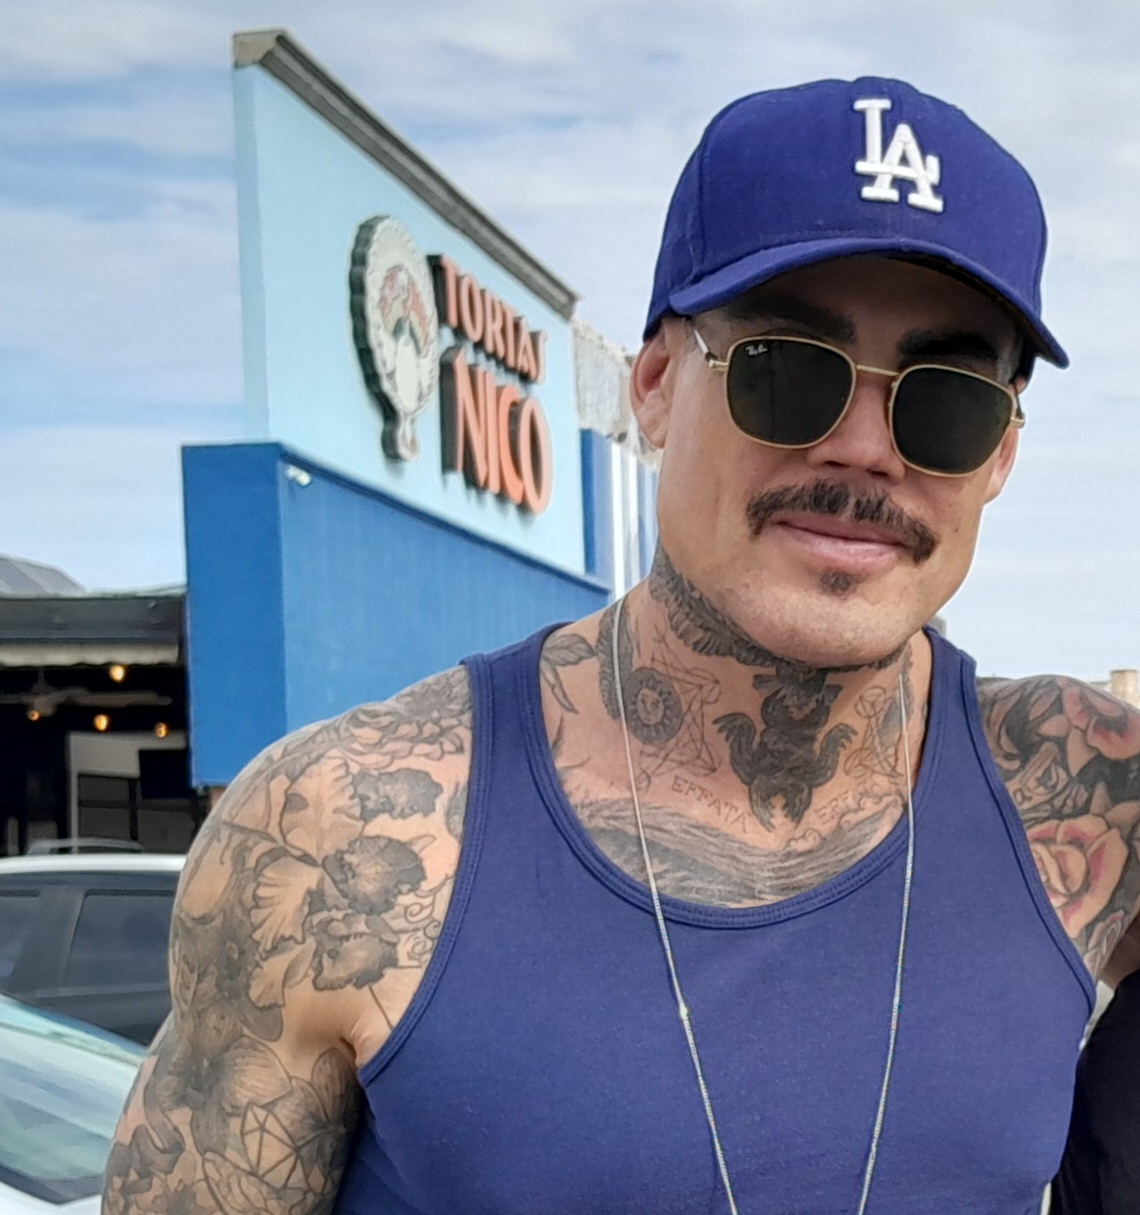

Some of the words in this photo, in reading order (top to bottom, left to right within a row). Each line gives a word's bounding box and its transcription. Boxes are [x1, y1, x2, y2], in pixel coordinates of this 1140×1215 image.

[853, 98, 944, 213] LA
[431, 255, 548, 384] TORTAS
[442, 348, 553, 514] NICO
